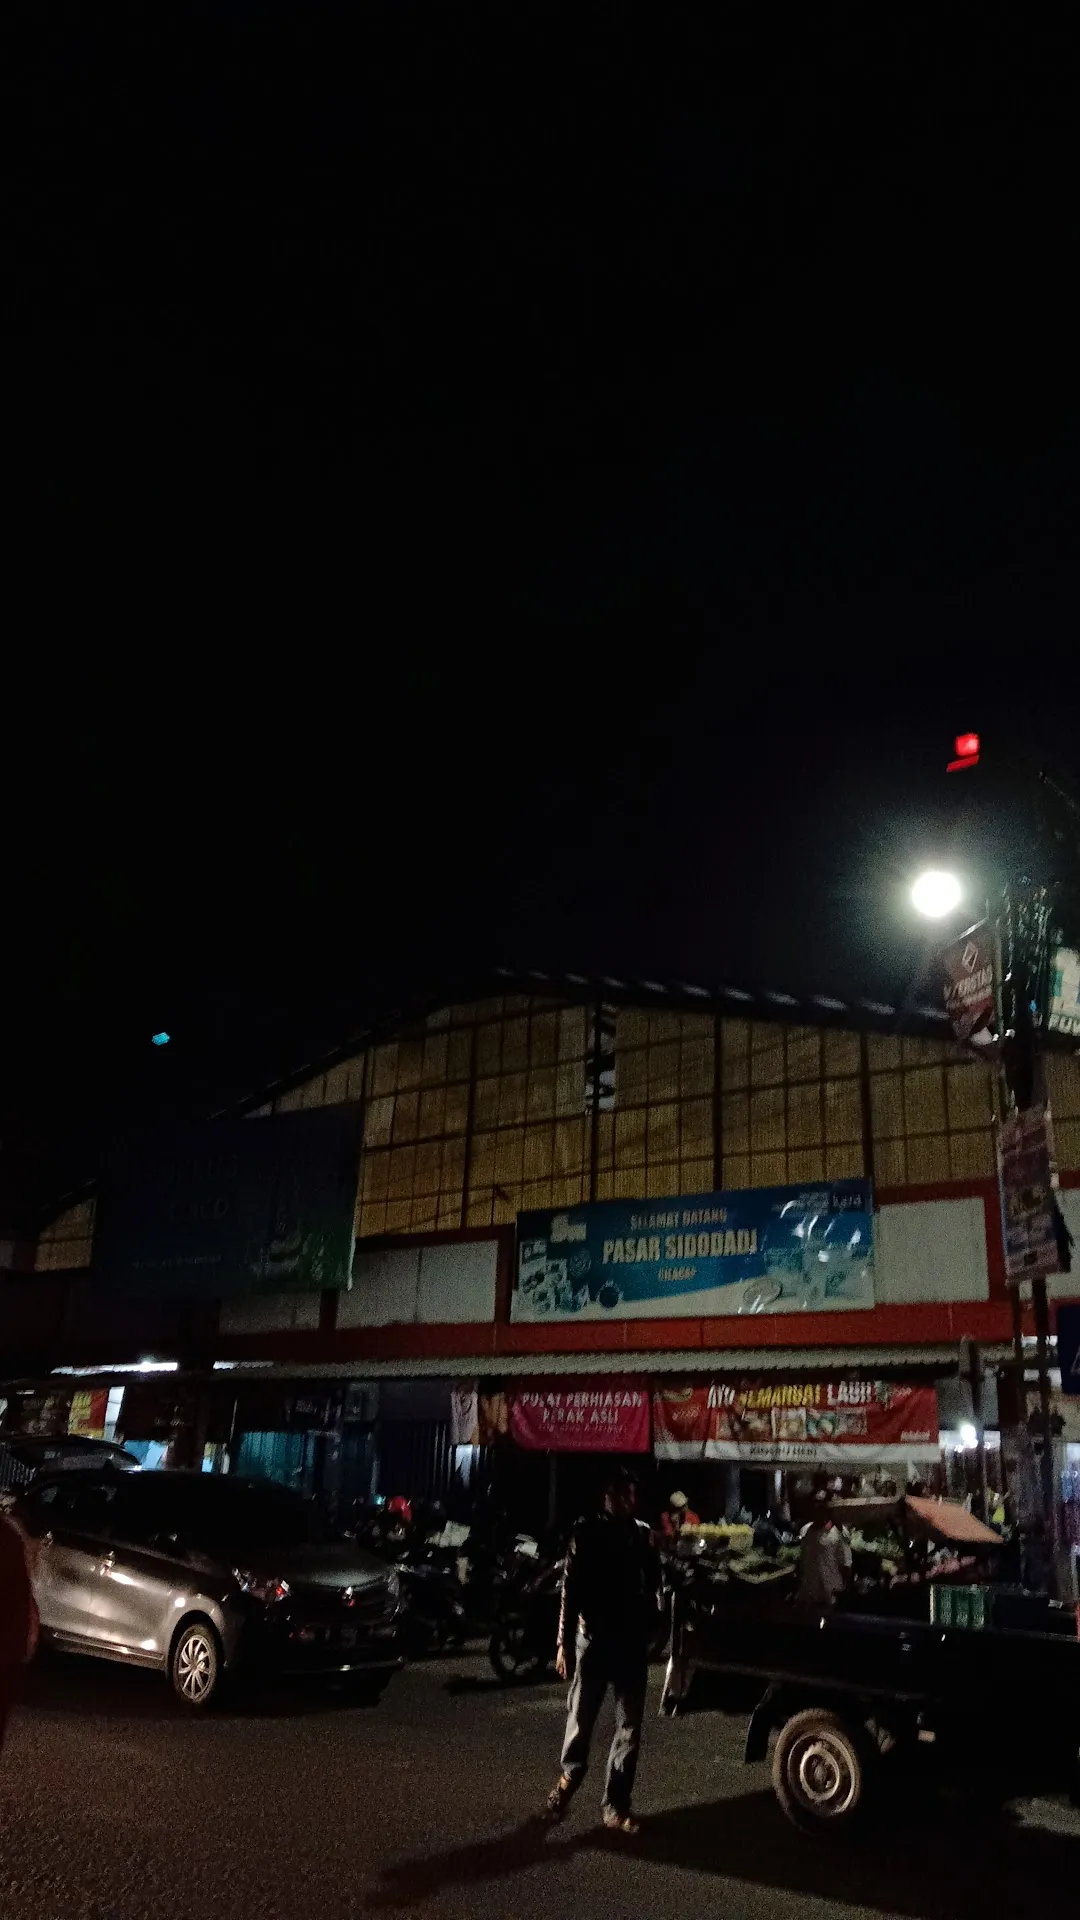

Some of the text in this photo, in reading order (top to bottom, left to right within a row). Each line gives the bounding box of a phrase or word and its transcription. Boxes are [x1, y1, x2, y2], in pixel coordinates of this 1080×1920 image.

[602, 1228, 758, 1264] PASAR SIDODADI
[565, 1390, 642, 1408] PERHIASAN
